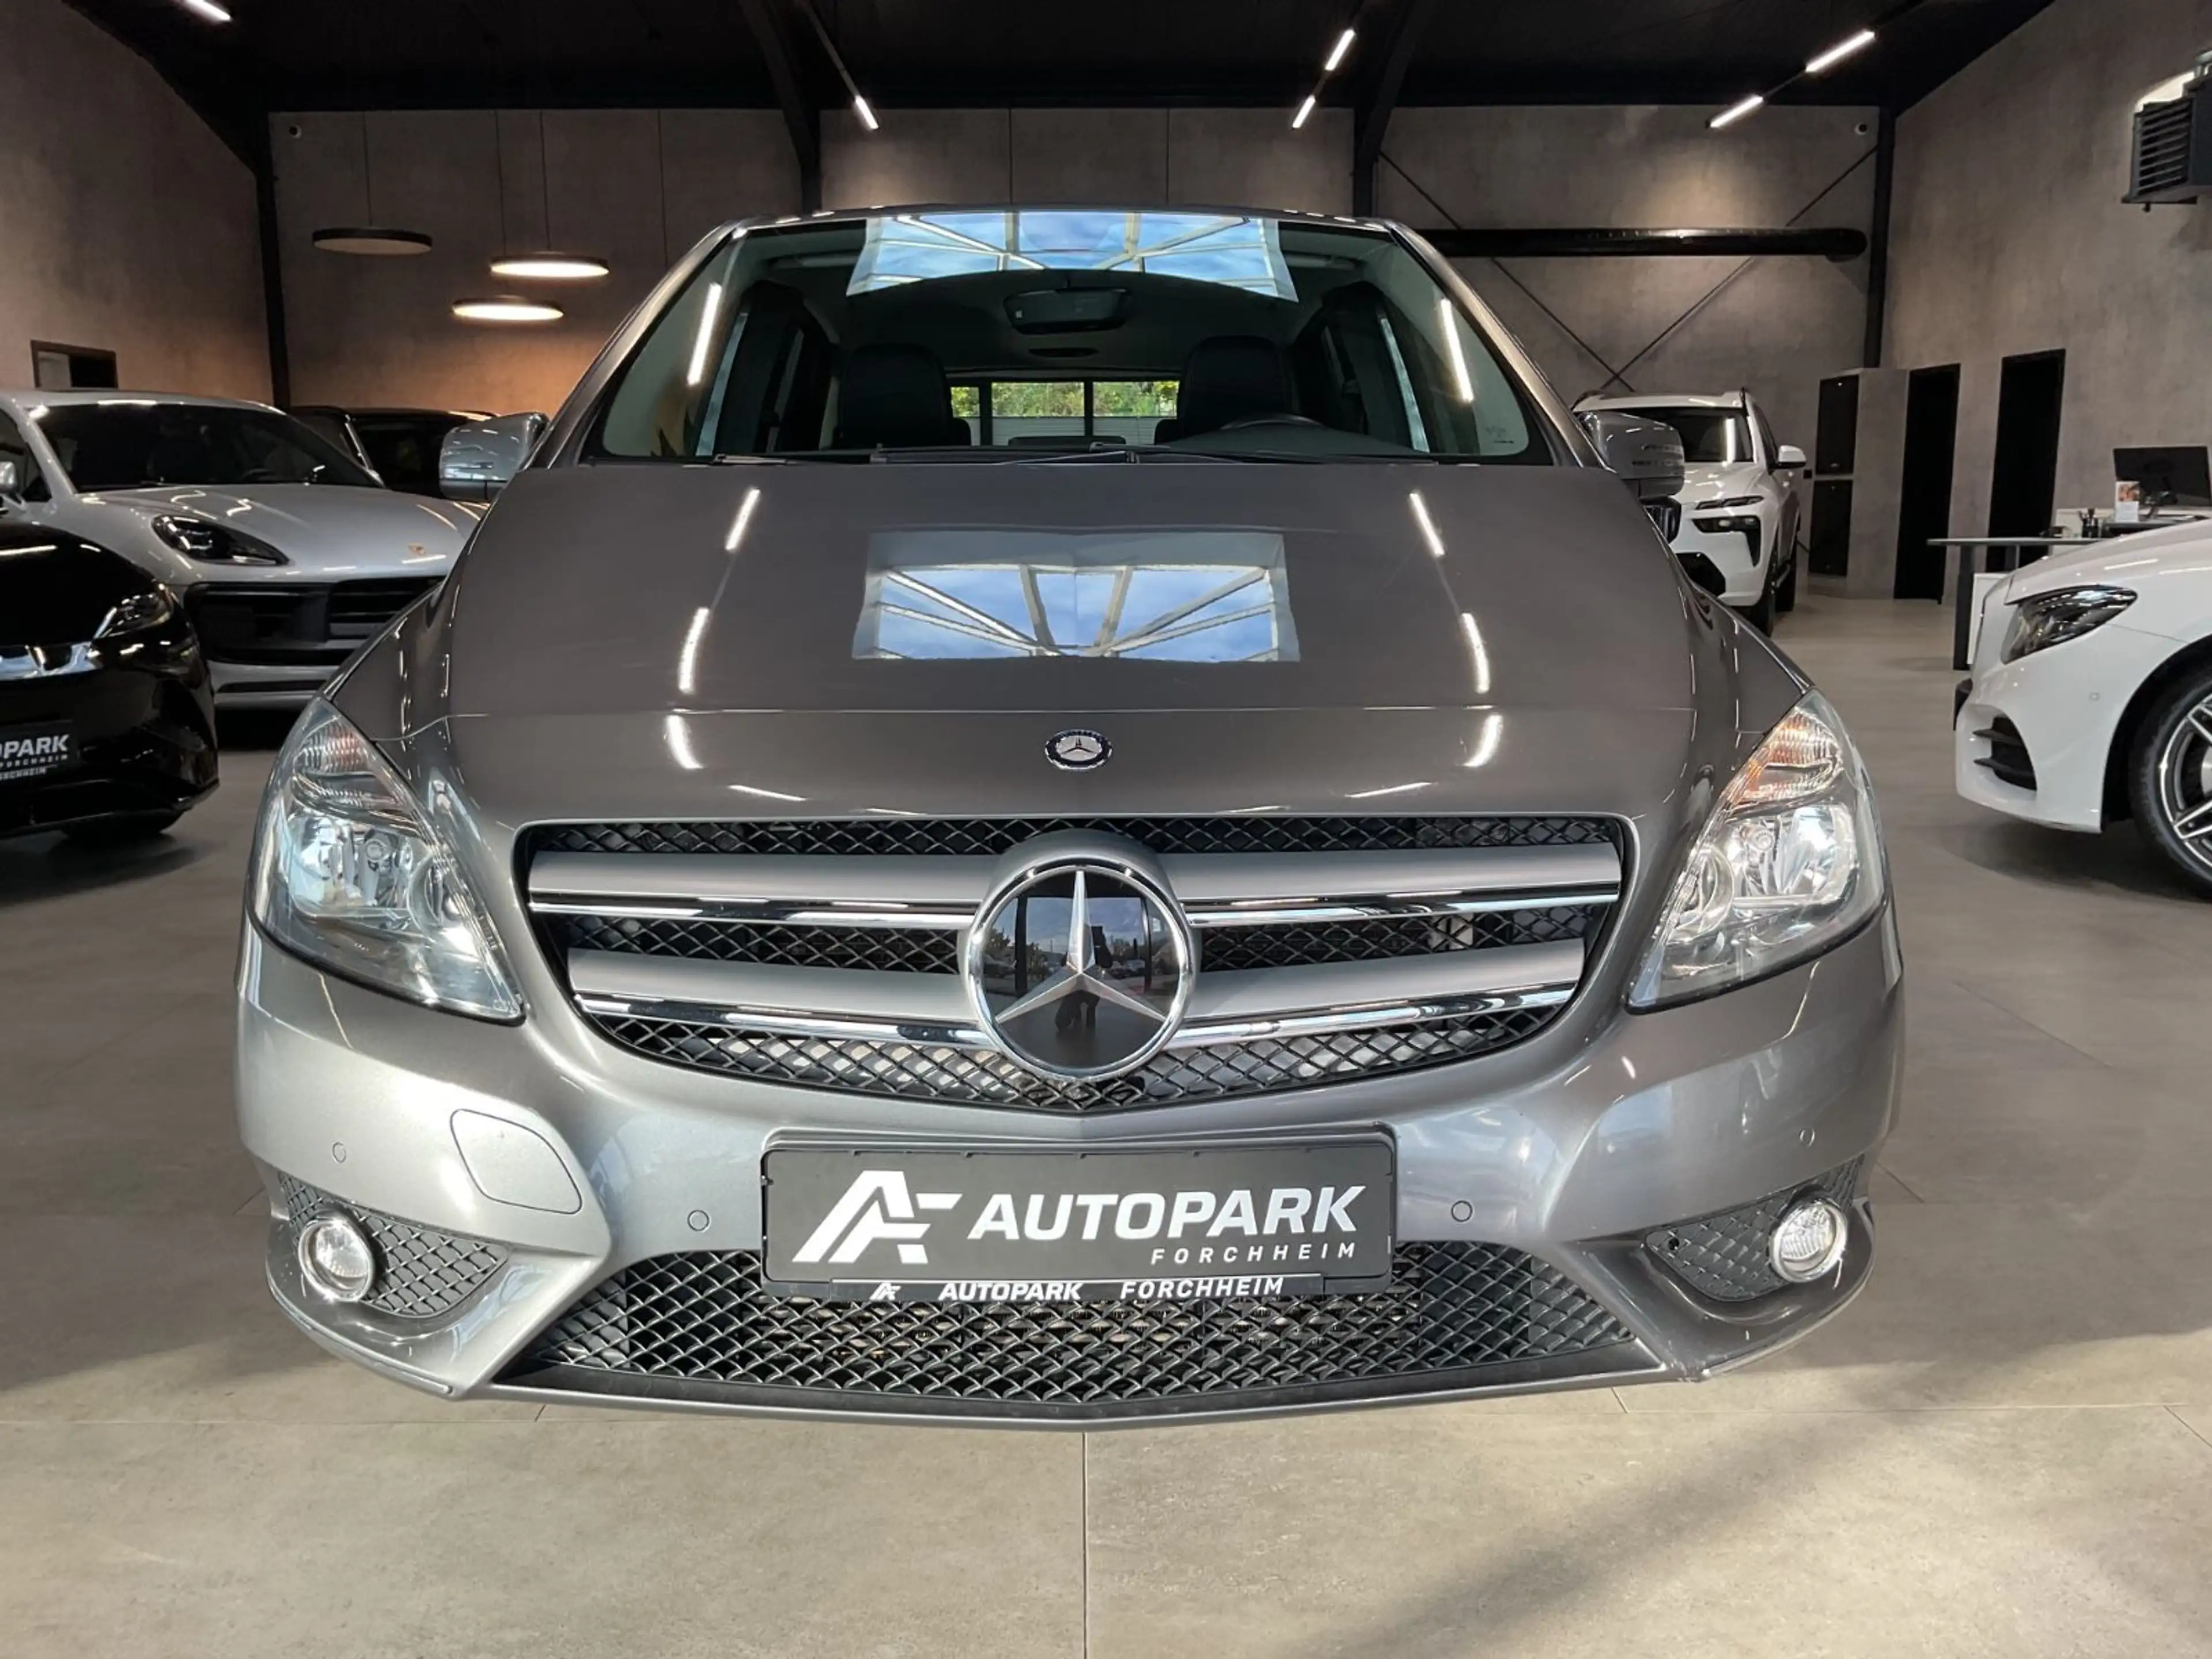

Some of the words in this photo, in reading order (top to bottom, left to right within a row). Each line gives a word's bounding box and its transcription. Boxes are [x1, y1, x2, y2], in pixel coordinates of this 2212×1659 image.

[966, 1185, 1366, 1240] AUTOPARK
[1150, 1242, 1355, 1266] FORCHHEIM
[939, 1281, 1082, 1302] AUTOPARK
[1120, 1277, 1284, 1300] FORCHHEIM
